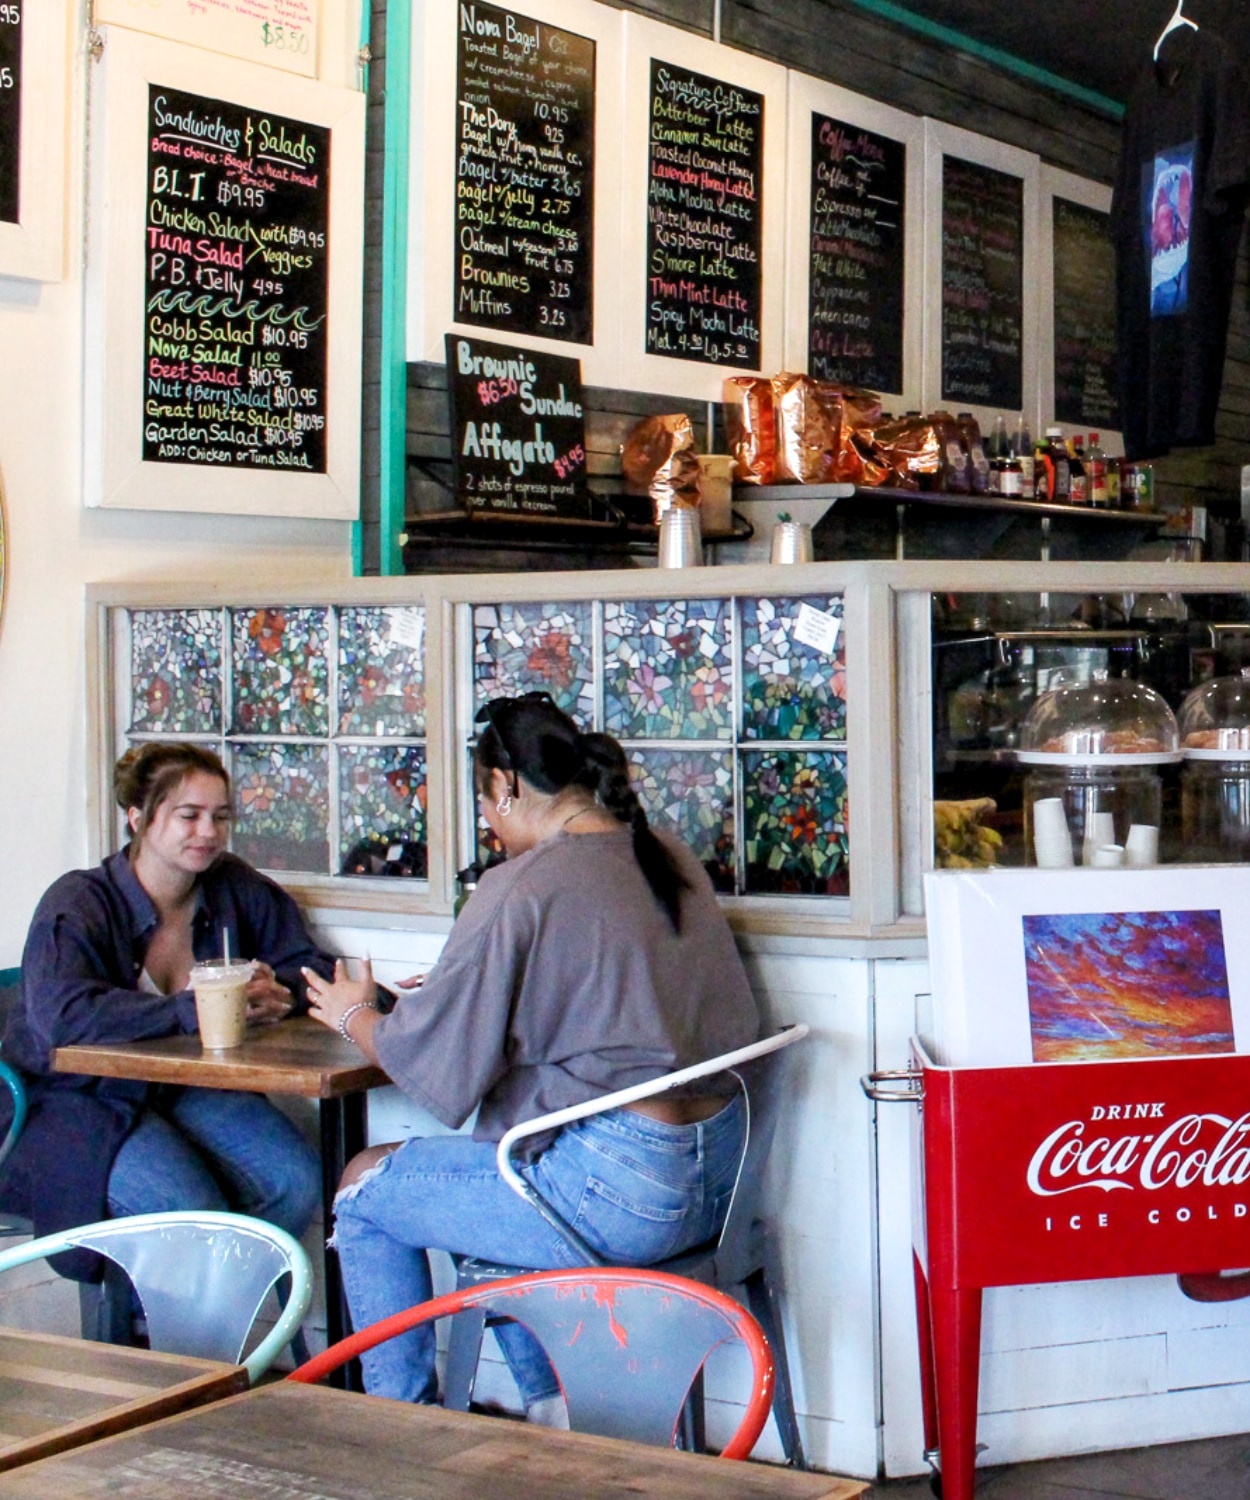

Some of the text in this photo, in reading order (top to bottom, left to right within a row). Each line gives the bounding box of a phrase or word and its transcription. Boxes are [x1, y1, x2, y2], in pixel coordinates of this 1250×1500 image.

[506, 14, 539, 54] Bagel
[462, 37, 498, 56] Toasted
[503, 45, 524, 66] Bagel
[656, 68, 760, 114] Signature Coffees
[459, 101, 488, 127] The
[534, 101, 568, 124] 10.95
[717, 114, 754, 141] Latte
[154, 95, 240, 148] Sandwiches
[258, 119, 316, 163] Salads
[463, 122, 491, 148] Bagel
[152, 138, 180, 155] Bread
[649, 142, 691, 166] Toasted
[692, 151, 727, 175] Coconut
[722, 138, 751, 156] Latte
[153, 166, 265, 207] B.L.T. $9.95
[459, 156, 497, 188] Bagel
[652, 160, 757, 207] Lavender Honey Latte
[817, 161, 854, 189] Coffee
[457, 181, 572, 214] Bagel 2.75
[679, 186, 716, 212] Mocha
[719, 201, 752, 221] Latte
[815, 187, 862, 222] Espresso
[150, 199, 249, 242] Chicken Salad
[261, 223, 324, 248] with $9.95
[458, 203, 578, 240] Bagel cheese
[649, 205, 736, 239] White Chocolate
[147, 227, 243, 270] Tuna Salad
[460, 226, 509, 257] Oatmeal
[656, 224, 758, 262] Raspberry Latte
[461, 254, 530, 293] Brownies
[525, 253, 550, 270] fruit
[700, 255, 738, 279] Latte
[202, 267, 245, 304] Jelly
[459, 285, 513, 315] Muffins
[650, 277, 748, 312] Thin Mint Latte
[150, 315, 309, 349] Cobb Salad $10.95
[690, 306, 727, 331] Mocha
[729, 313, 760, 342] Latte
[812, 305, 870, 329] Americano
[149, 337, 191, 360] Nova
[191, 343, 243, 367] Salad
[457, 340, 538, 382] Brownie
[149, 357, 293, 388] Beet Salad $10.95
[813, 356, 853, 381] Mocha
[148, 378, 182, 398] Nut
[194, 384, 230, 412] Berry
[231, 387, 273, 411] Salad
[274, 385, 318, 408] $10.95
[520, 382, 583, 418] Sundae
[145, 399, 195, 419] Great
[198, 403, 246, 422] White
[247, 408, 294, 431] Salad
[145, 422, 304, 449] Garden Salad $10.95
[462, 420, 554, 477] Affogato
[187, 446, 232, 462] Chicken
[237, 452, 249, 461] or
[248, 449, 275, 465] Tuna
[276, 450, 314, 469] Salad
[465, 473, 575, 501] 2 shots of espresso poured
[491, 494, 518, 509] vanilla
[1090, 1102, 1166, 1121] DRINK
[1046, 1203, 1248, 1231] ICE COLD
